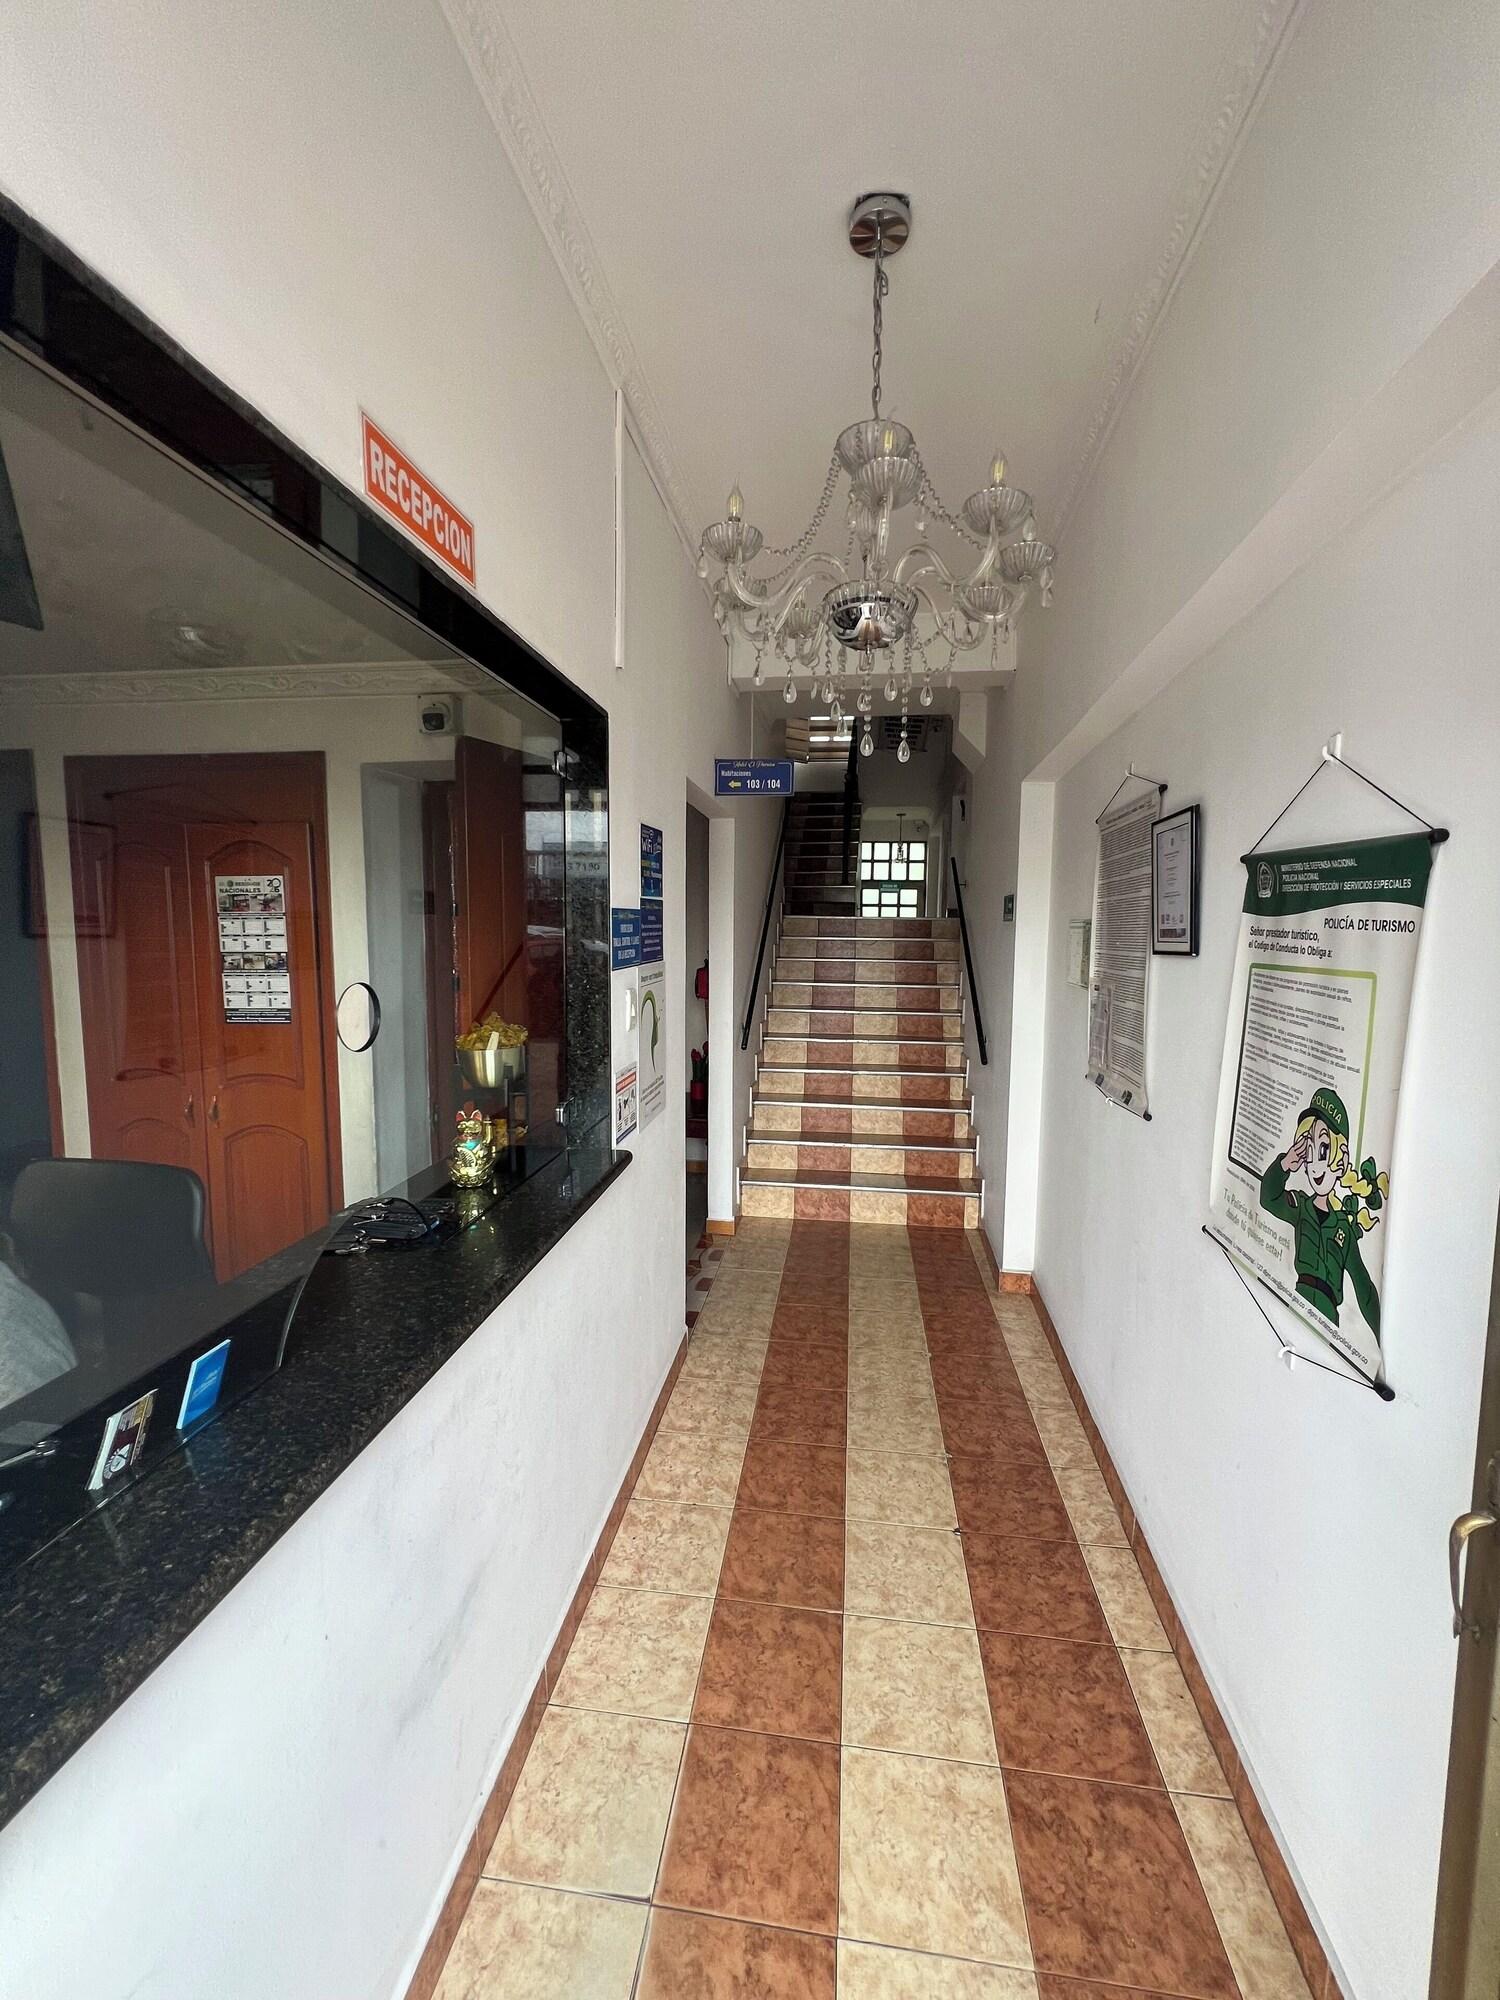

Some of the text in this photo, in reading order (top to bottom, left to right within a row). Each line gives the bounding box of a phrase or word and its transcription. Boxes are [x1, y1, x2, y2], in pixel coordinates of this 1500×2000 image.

[370, 439, 472, 571] RECEPCION
[746, 779, 760, 788] 103
[767, 779, 780, 788] 104
[1310, 860, 1331, 870] DEFENSA
[1332, 858, 1358, 868] NACIONAL
[1298, 872, 1320, 880] NACIONAL
[1344, 880, 1373, 890] SERVICIOS
[1373, 879, 1412, 889] ESPECIALES
[1250, 926, 1265, 936] Señor
[1265, 928, 1290, 939] prestador
[1324, 916, 1416, 933] POLICÍA DE TURISMO
[1248, 940, 1254, 948] el
[1270, 942, 1275, 950] de
[1276, 942, 1298, 954] Conducta
[1300, 946, 1306, 955] lo
[1307, 946, 1326, 960] Obliga
[1327, 950, 1332, 958] a:
[1312, 1096, 1342, 1124] POLICIA
[1224, 1188, 1230, 1203] Tu
[1255, 1212, 1277, 1240] Turismo
[1266, 1243, 1283, 1262] estar!
